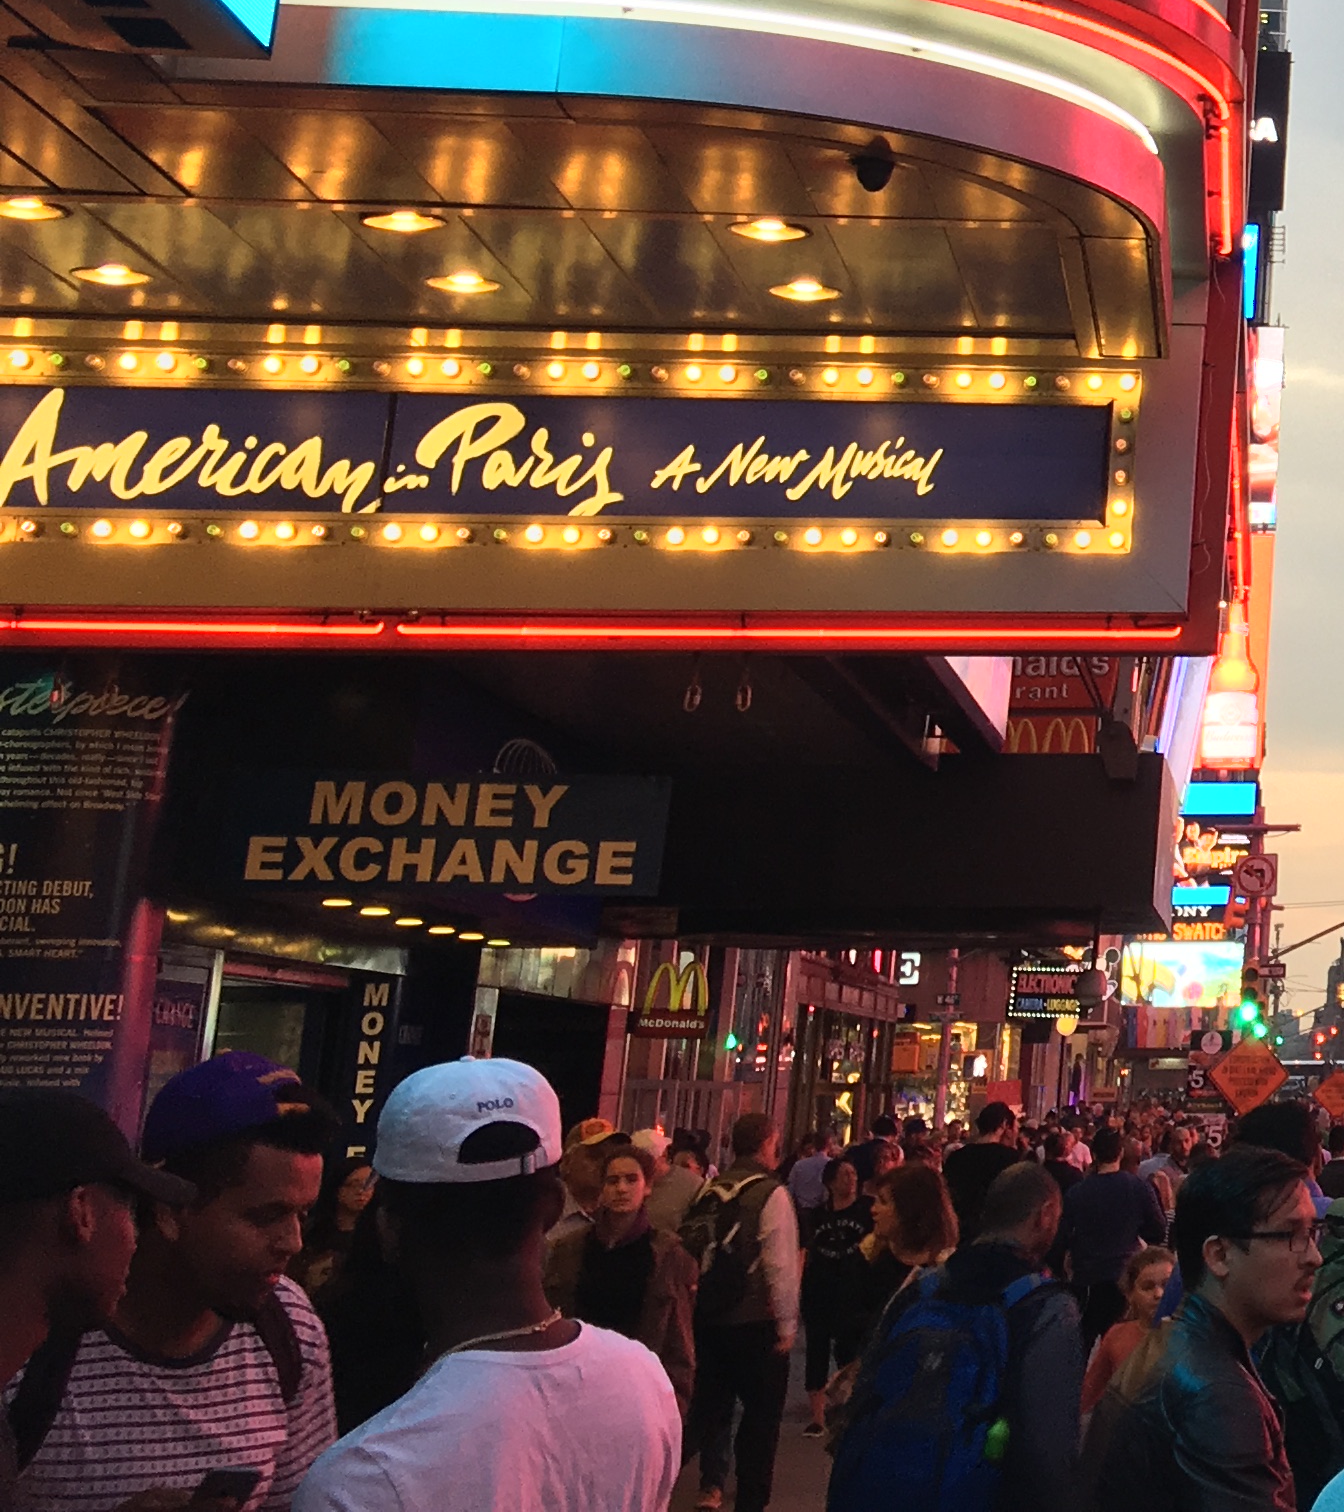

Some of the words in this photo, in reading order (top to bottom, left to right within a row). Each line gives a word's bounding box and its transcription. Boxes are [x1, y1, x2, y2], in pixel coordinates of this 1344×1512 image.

[0, 388, 381, 513] American
[383, 462, 430, 493] in
[415, 402, 624, 516] Paris
[651, 444, 701, 491] A
[697, 435, 813, 494] New
[787, 437, 943, 500] Musical
[308, 780, 571, 829] MONEY
[242, 835, 638, 886] EXCHANGE
[31, 898, 61, 915] HAS
[41, 880, 95, 899] DEBUT,
[636, 1018, 705, 1031] McDonald's
[352, 982, 390, 1124] MONEY
[476, 1096, 515, 1113] POLO
